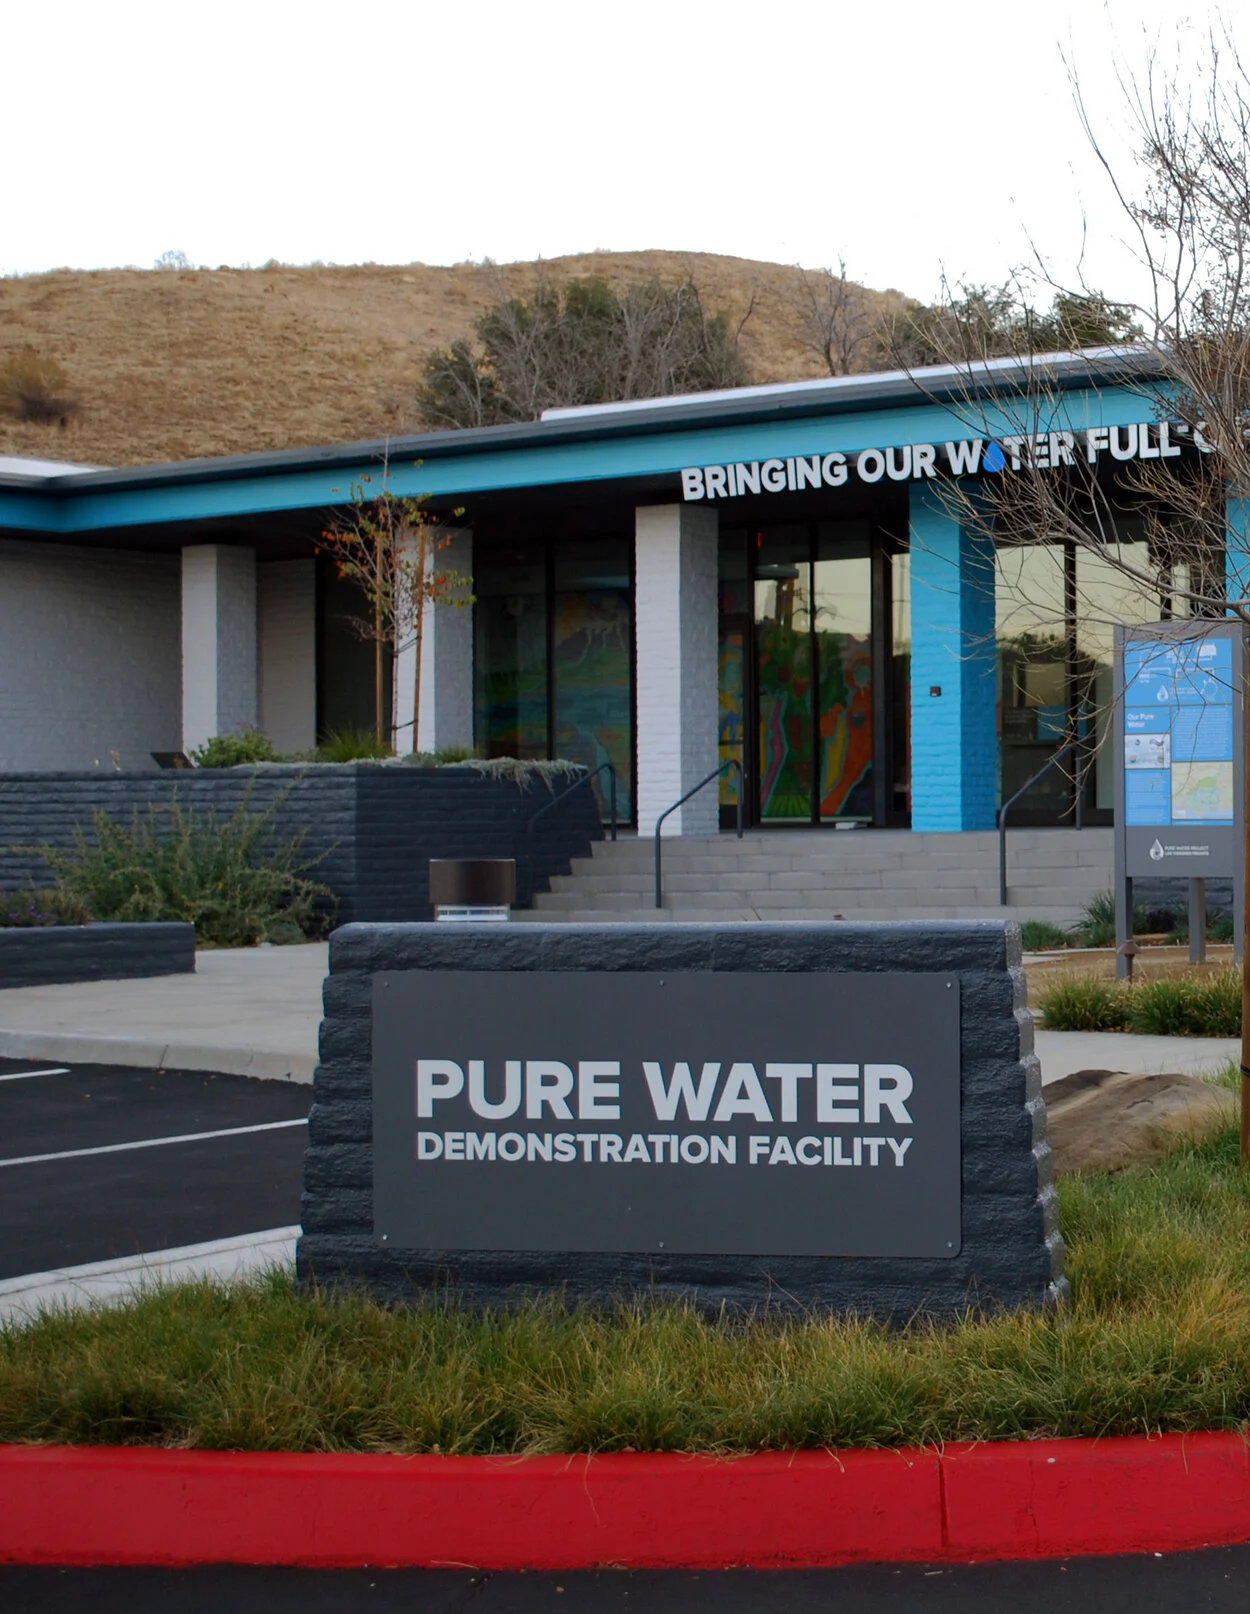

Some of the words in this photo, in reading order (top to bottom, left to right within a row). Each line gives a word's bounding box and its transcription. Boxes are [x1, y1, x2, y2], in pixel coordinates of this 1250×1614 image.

[681, 454, 848, 501] BRINGING
[856, 441, 937, 482] OUR
[945, 431, 1076, 476] WTER
[416, 1059, 621, 1120] PURE
[642, 1061, 914, 1124] WATER
[416, 1131, 737, 1165] DEMONSTRATION
[749, 1135, 914, 1167] FACILITY
